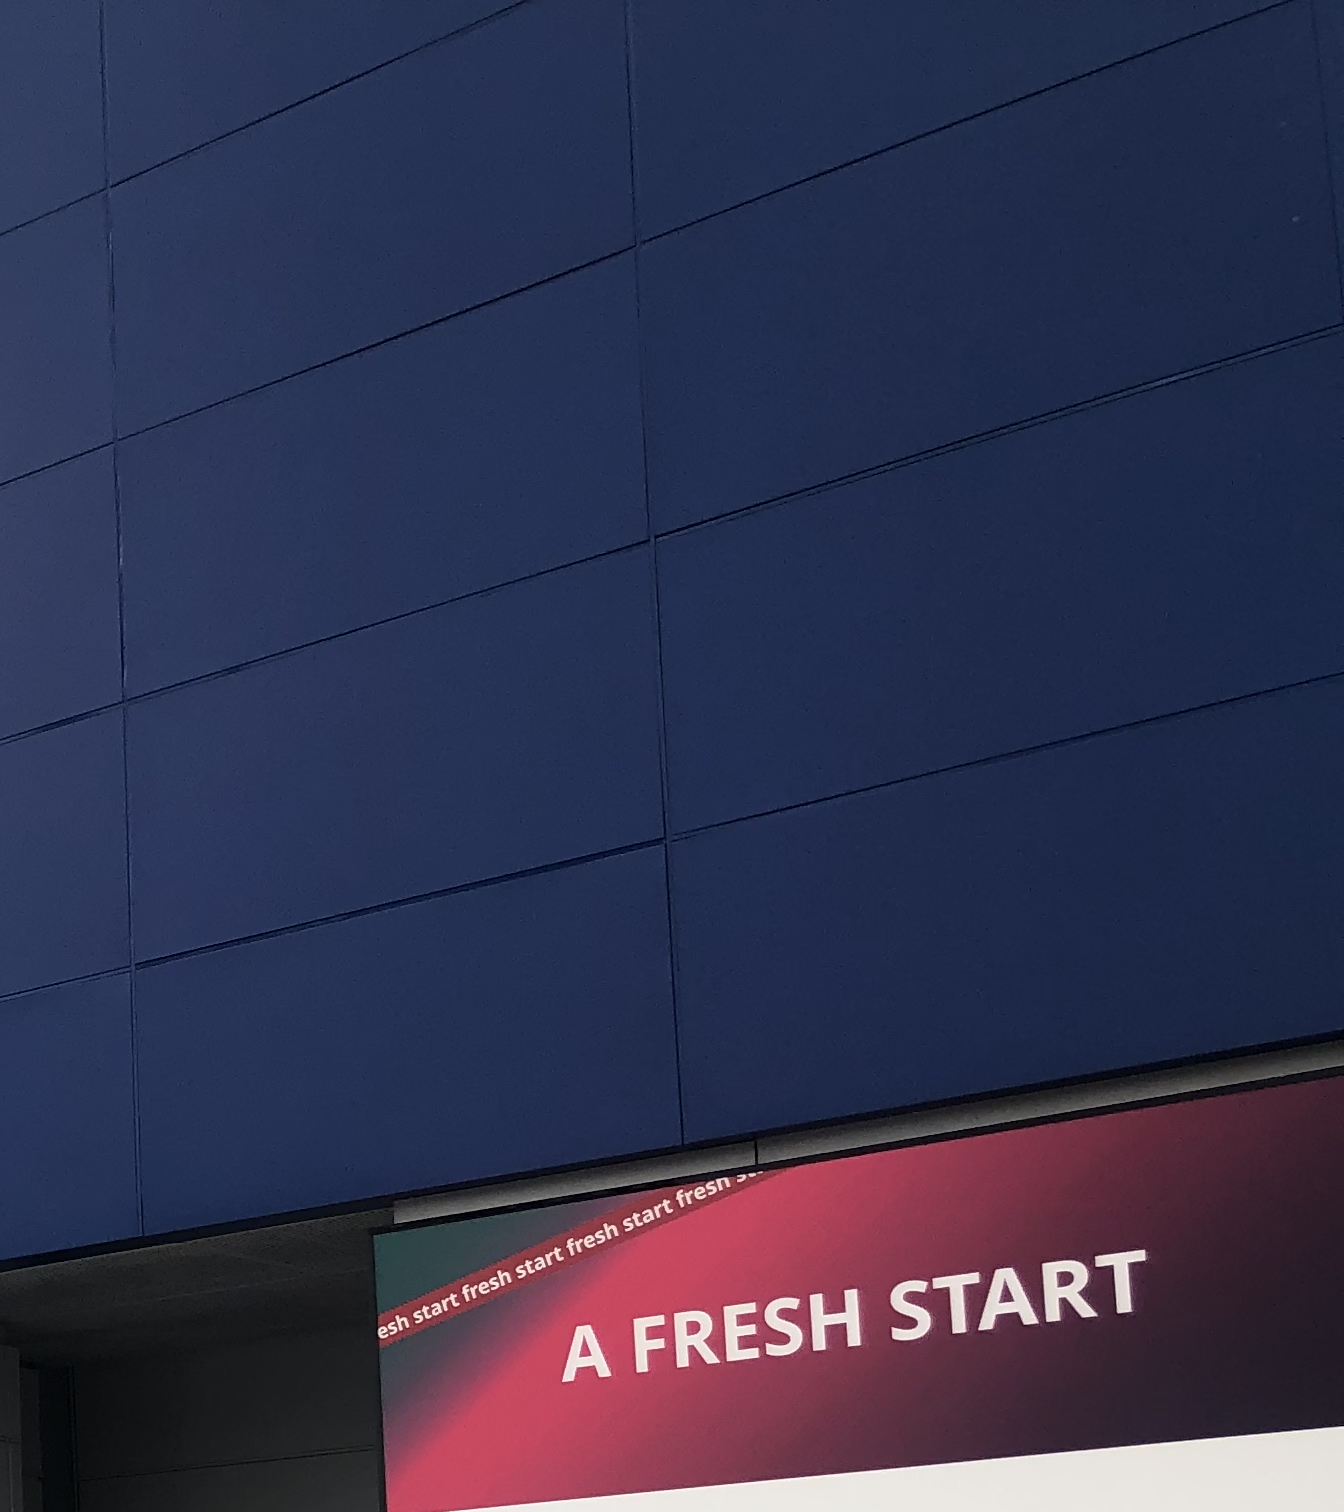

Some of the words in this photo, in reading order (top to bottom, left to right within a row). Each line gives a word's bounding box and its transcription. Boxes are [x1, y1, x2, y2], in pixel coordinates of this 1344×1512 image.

[377, 1315, 410, 1340] esh
[412, 1292, 461, 1324] start
[461, 1269, 513, 1303] fresh
[515, 1246, 565, 1280] start
[565, 1223, 620, 1257] fresh
[622, 1199, 674, 1233] start
[562, 1324, 612, 1384] A
[633, 1288, 861, 1374] FRESH
[888, 1248, 1148, 1343] START
